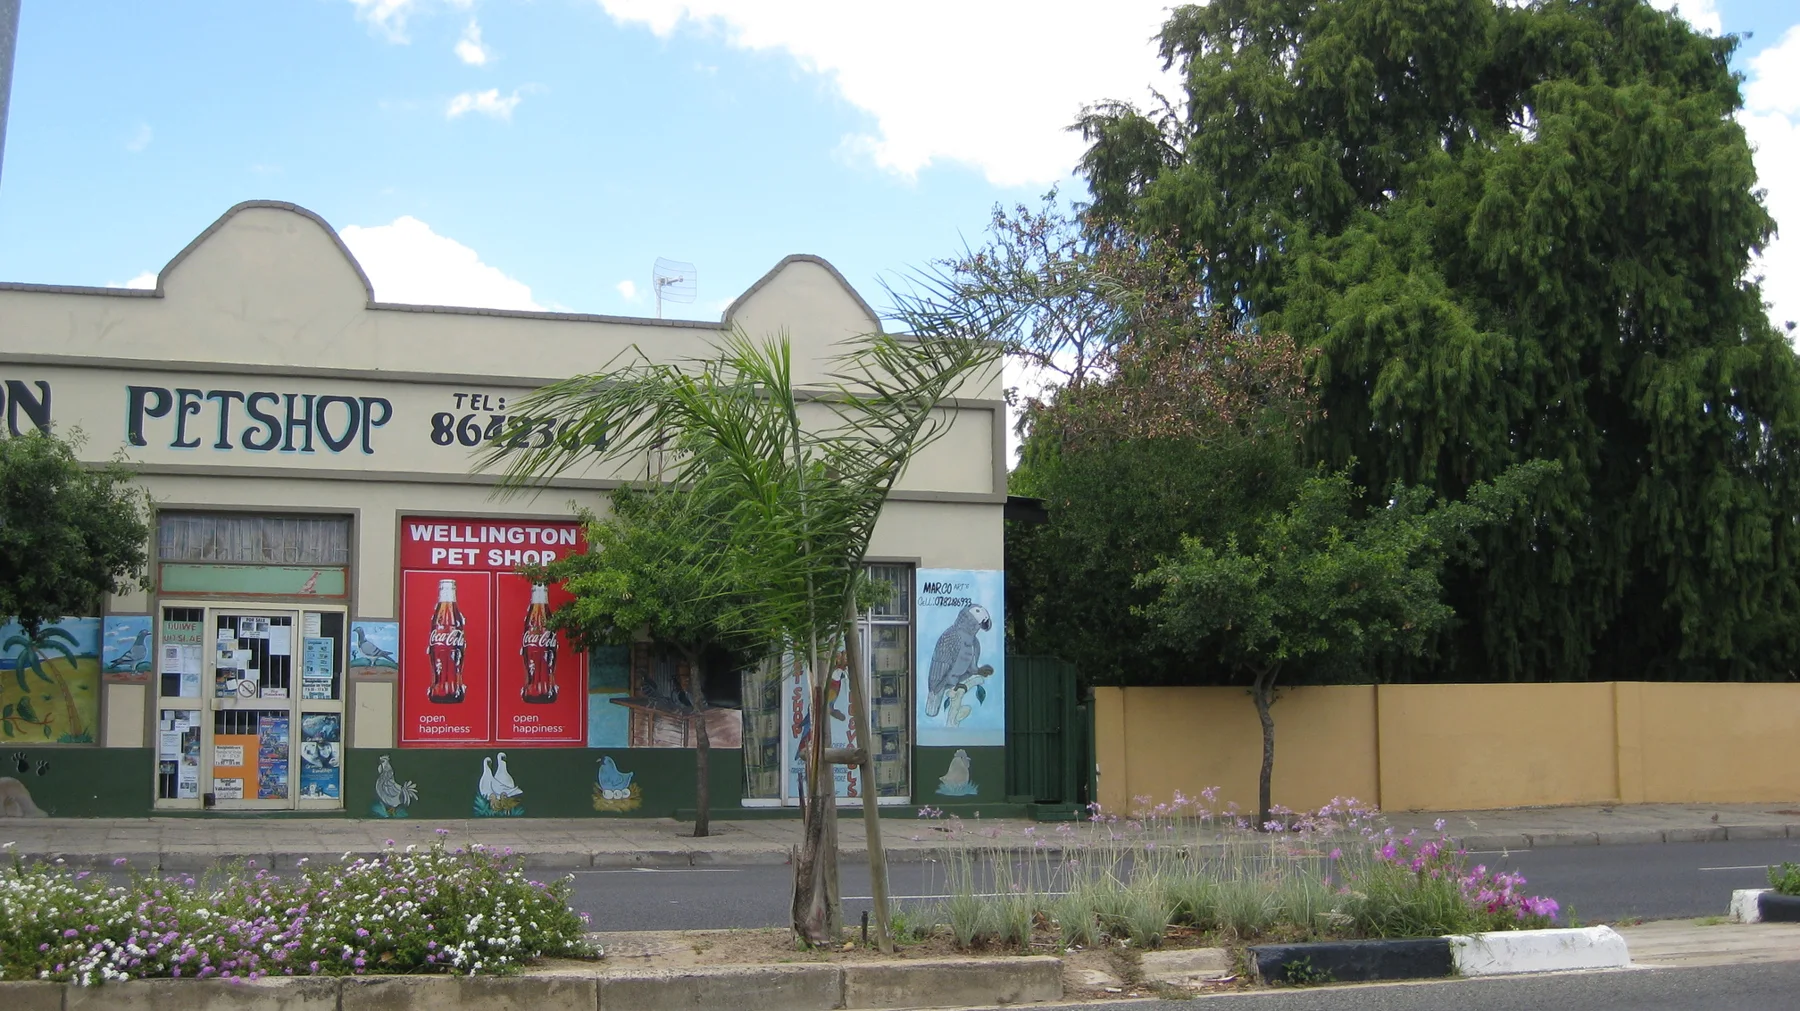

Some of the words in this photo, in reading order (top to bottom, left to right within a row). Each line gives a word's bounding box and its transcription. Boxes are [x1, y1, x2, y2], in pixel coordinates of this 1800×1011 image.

[453, 393, 506, 411] TEL:
[0, 379, 51, 438] N
[125, 384, 394, 455] PETSHOP
[410, 524, 577, 545] WELLINGTON
[431, 548, 480, 565] PET
[488, 549, 557, 567] SHOP
[922, 582, 953, 594] MARCO
[419, 714, 446, 725] open
[513, 714, 539, 725] open
[419, 724, 471, 734] happiness
[512, 723, 563, 734] happiness
